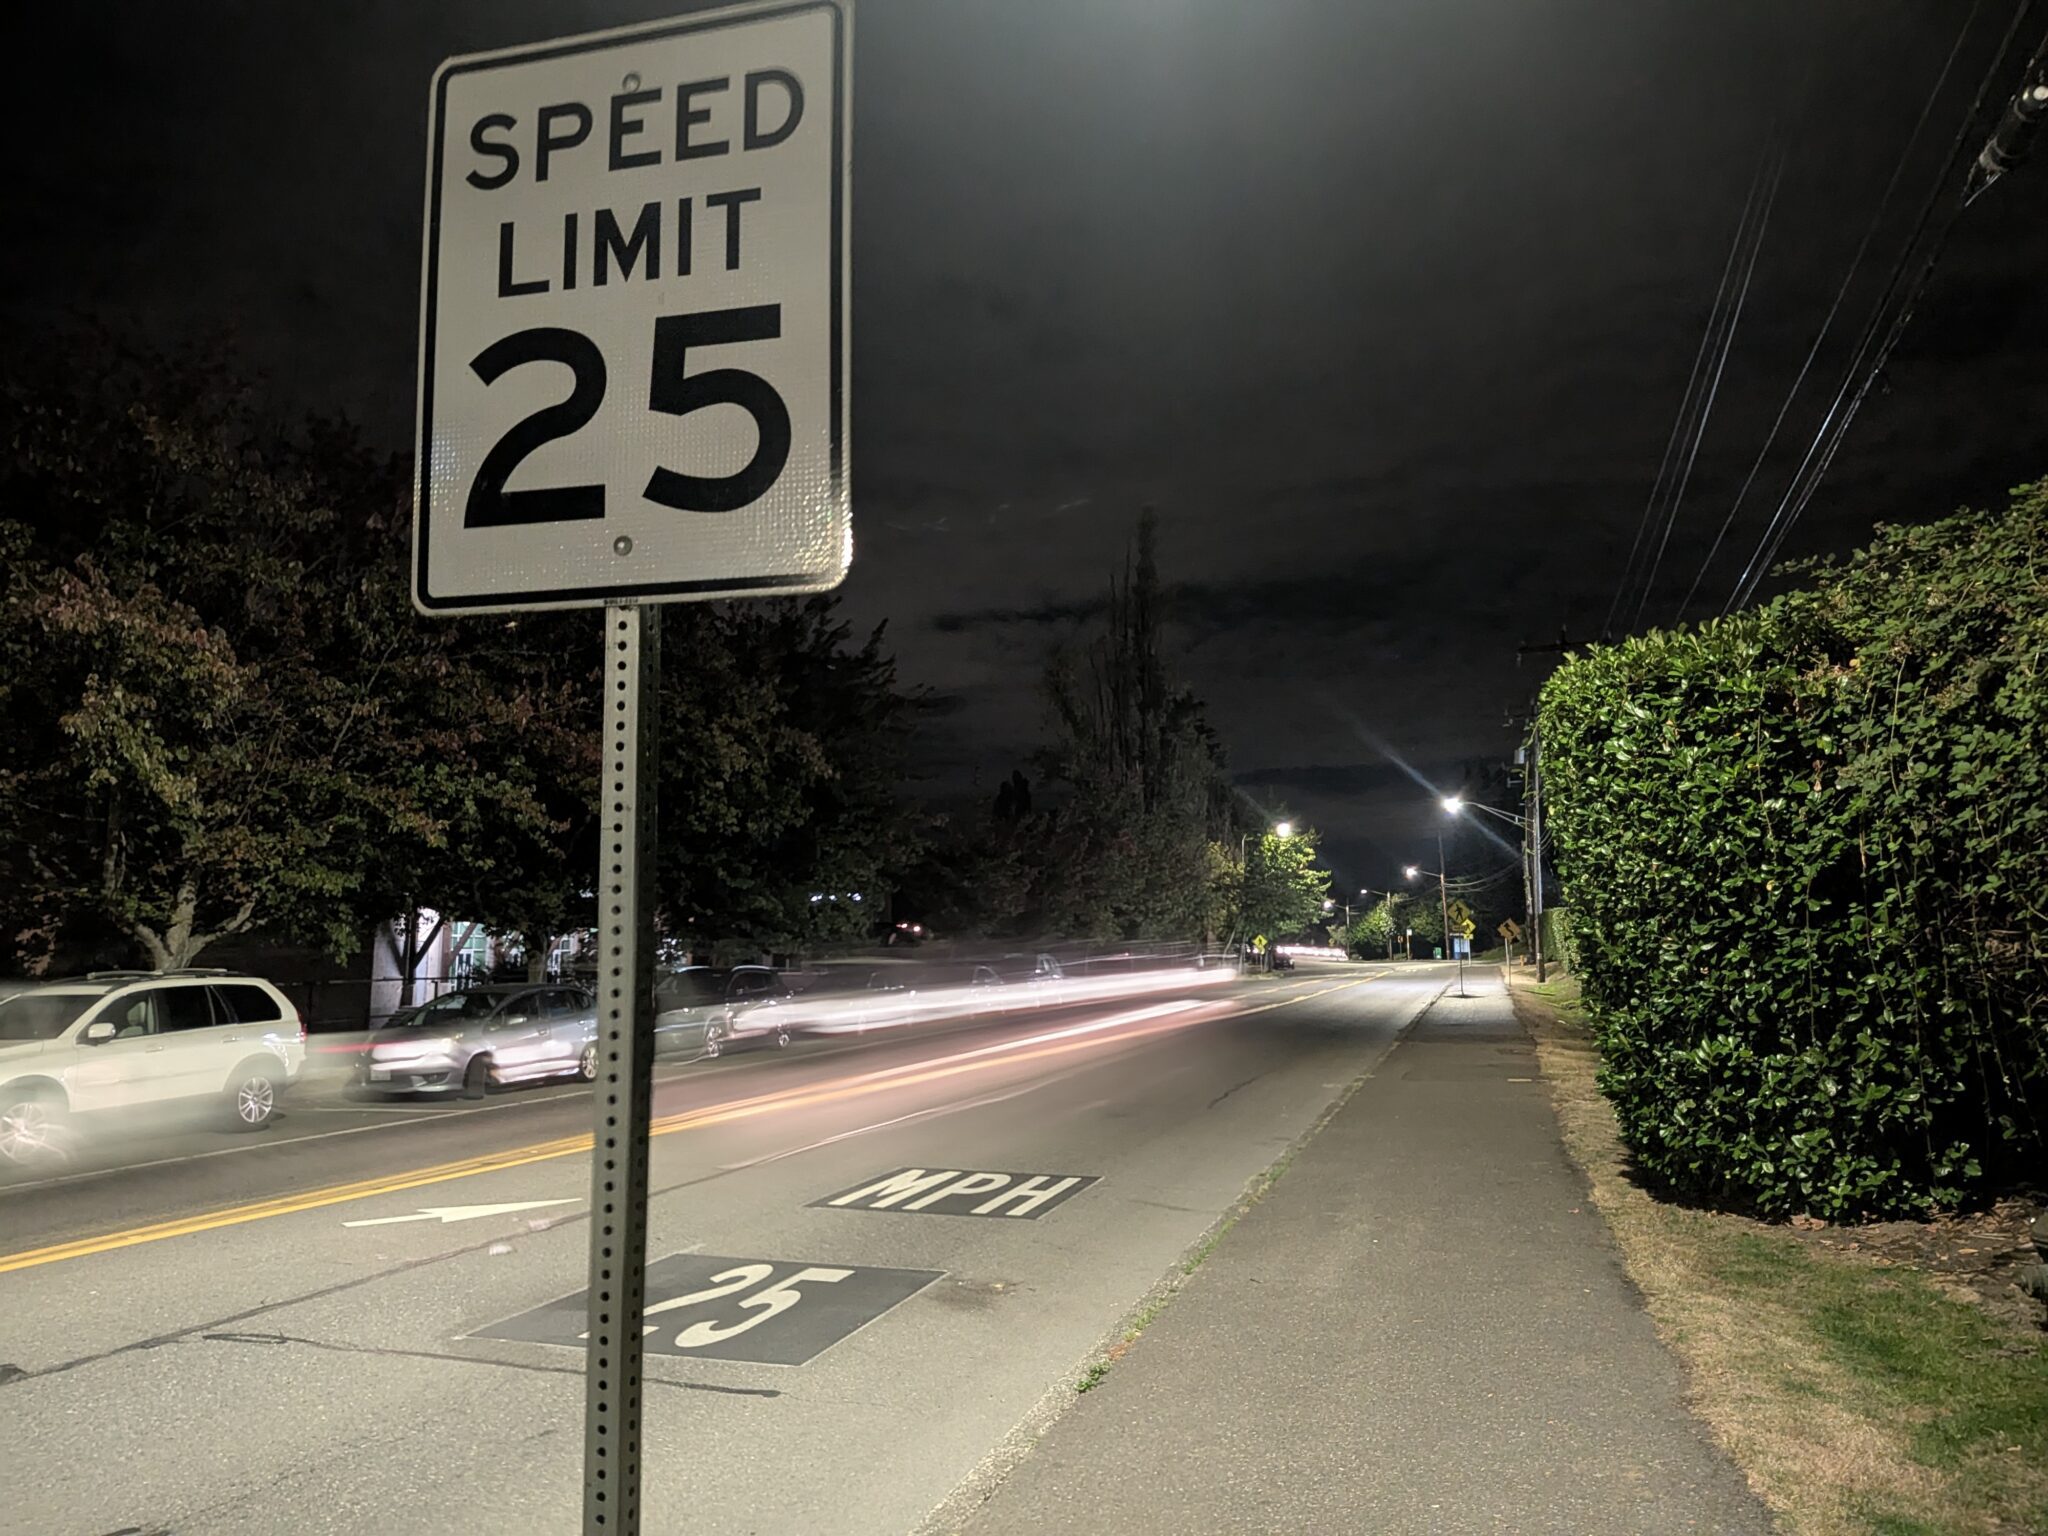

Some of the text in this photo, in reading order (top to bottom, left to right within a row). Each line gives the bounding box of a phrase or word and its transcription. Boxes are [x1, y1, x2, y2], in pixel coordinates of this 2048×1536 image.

[466, 69, 804, 190] SPEED
[498, 187, 762, 298] LIMIT
[464, 303, 792, 528] 25
[828, 1169, 1081, 1216] MPH
[577, 1264, 856, 1347] 25
